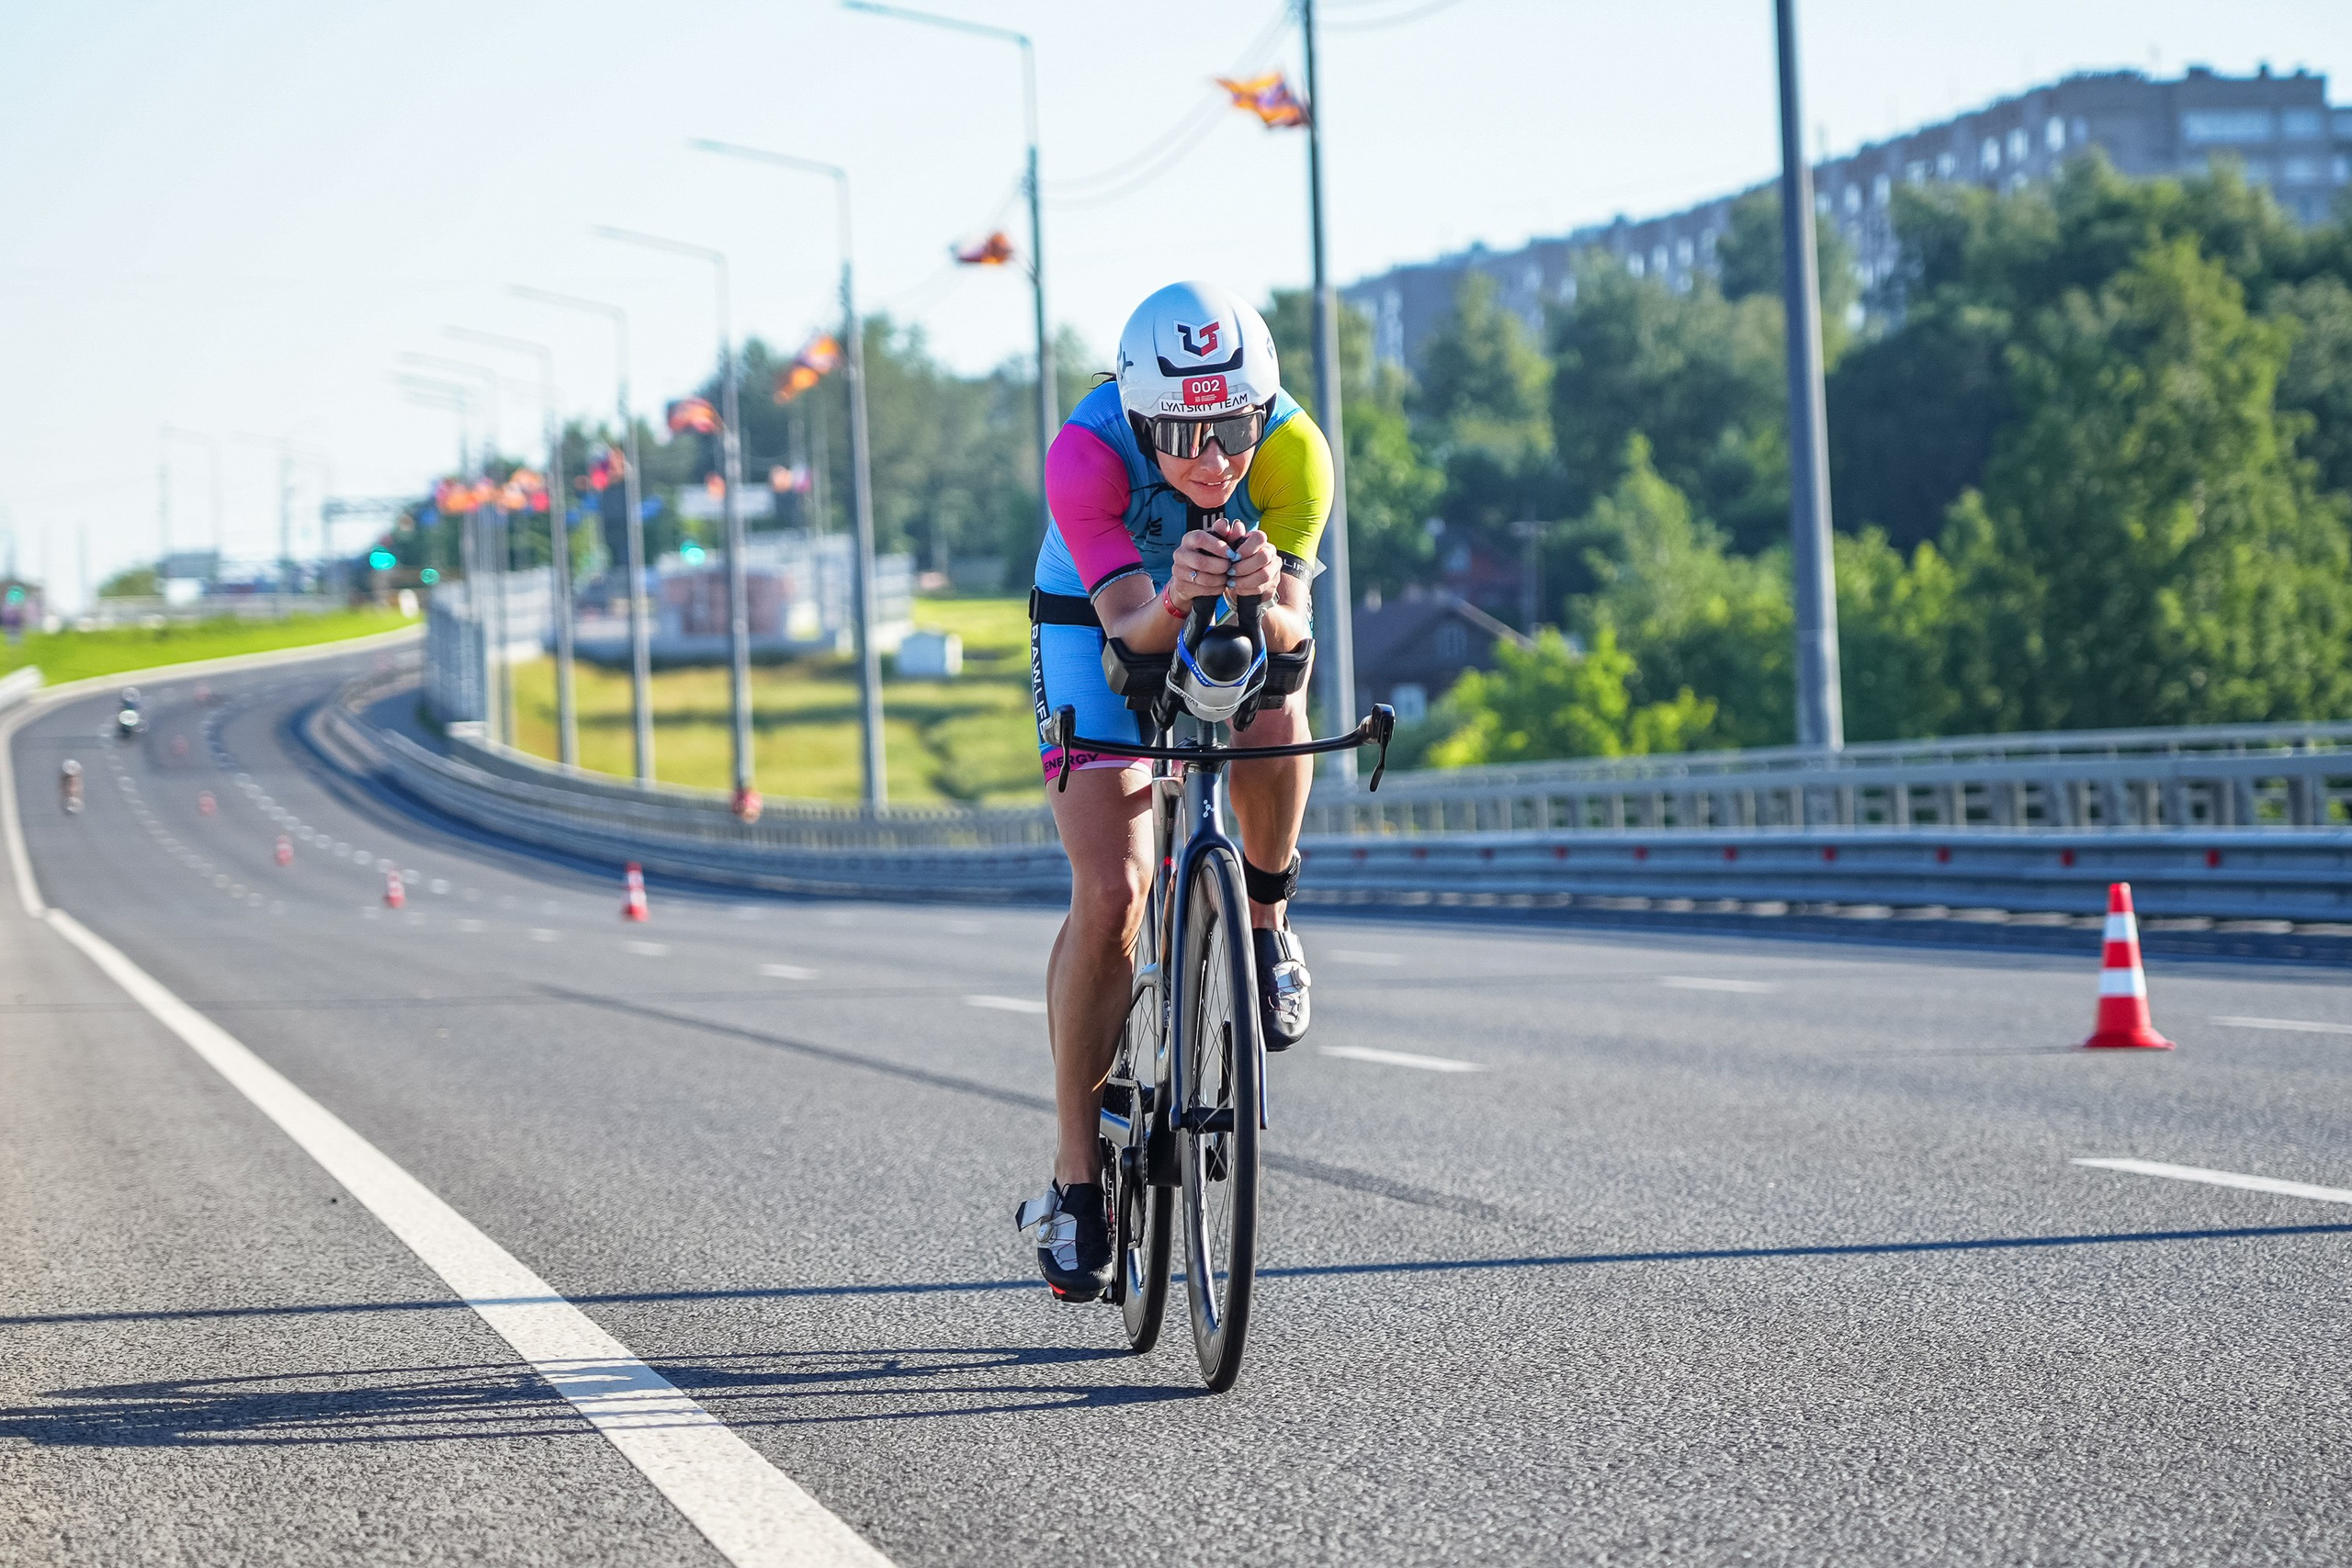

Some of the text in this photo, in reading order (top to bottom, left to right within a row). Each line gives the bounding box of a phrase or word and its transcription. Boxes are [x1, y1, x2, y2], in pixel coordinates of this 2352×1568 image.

[1192, 379, 1220, 394] 002
[1160, 400, 1214, 413] LYATSKIY
[1218, 393, 1249, 410] TEAM
[1044, 753, 1100, 773] ENERGY
